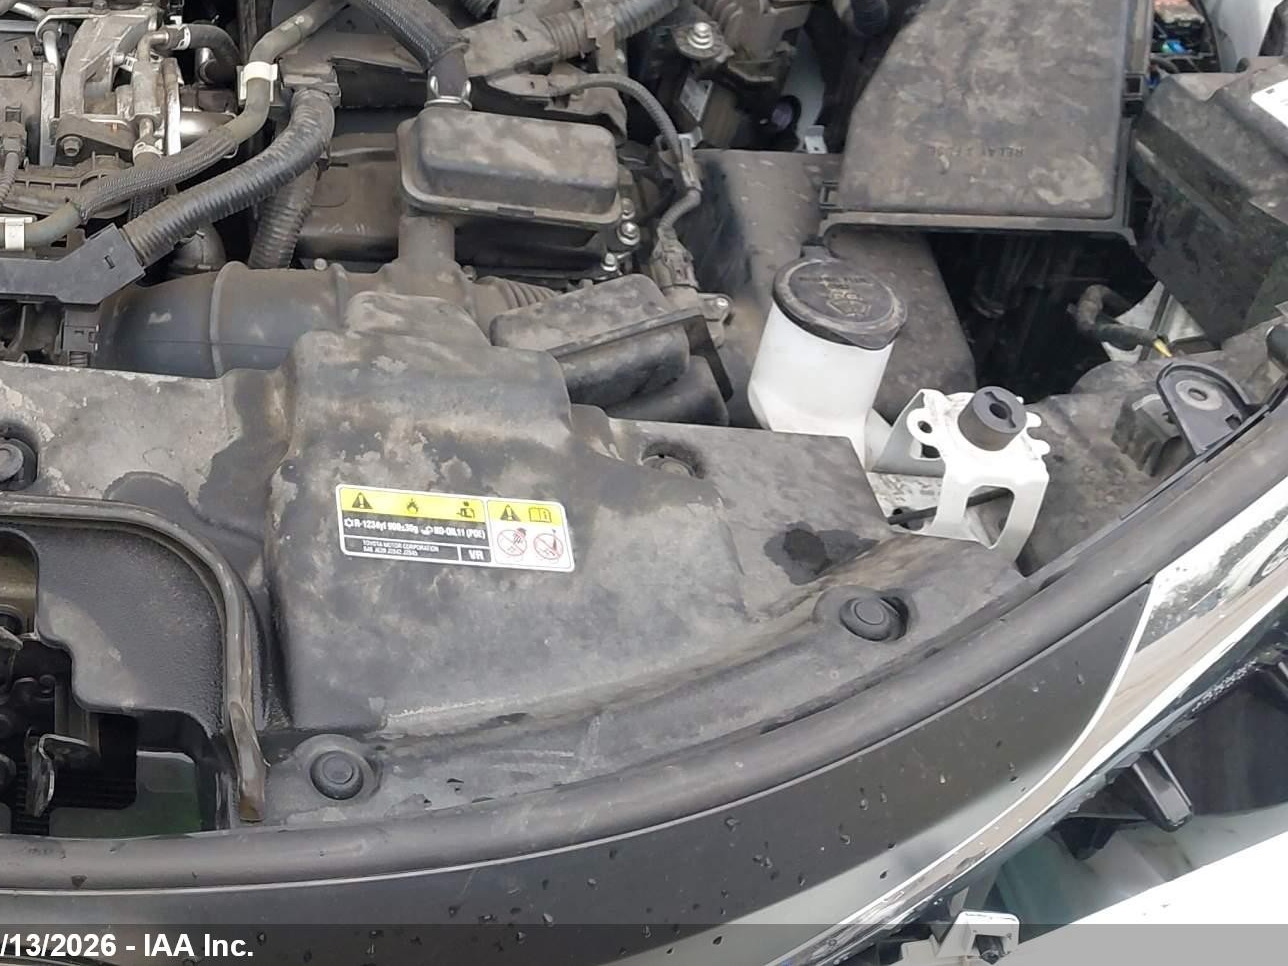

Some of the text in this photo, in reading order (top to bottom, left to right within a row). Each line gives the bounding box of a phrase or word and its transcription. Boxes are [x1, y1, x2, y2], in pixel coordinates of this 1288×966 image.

[362, 539, 439, 552] TOYOTA MOTOR CORPORATION
